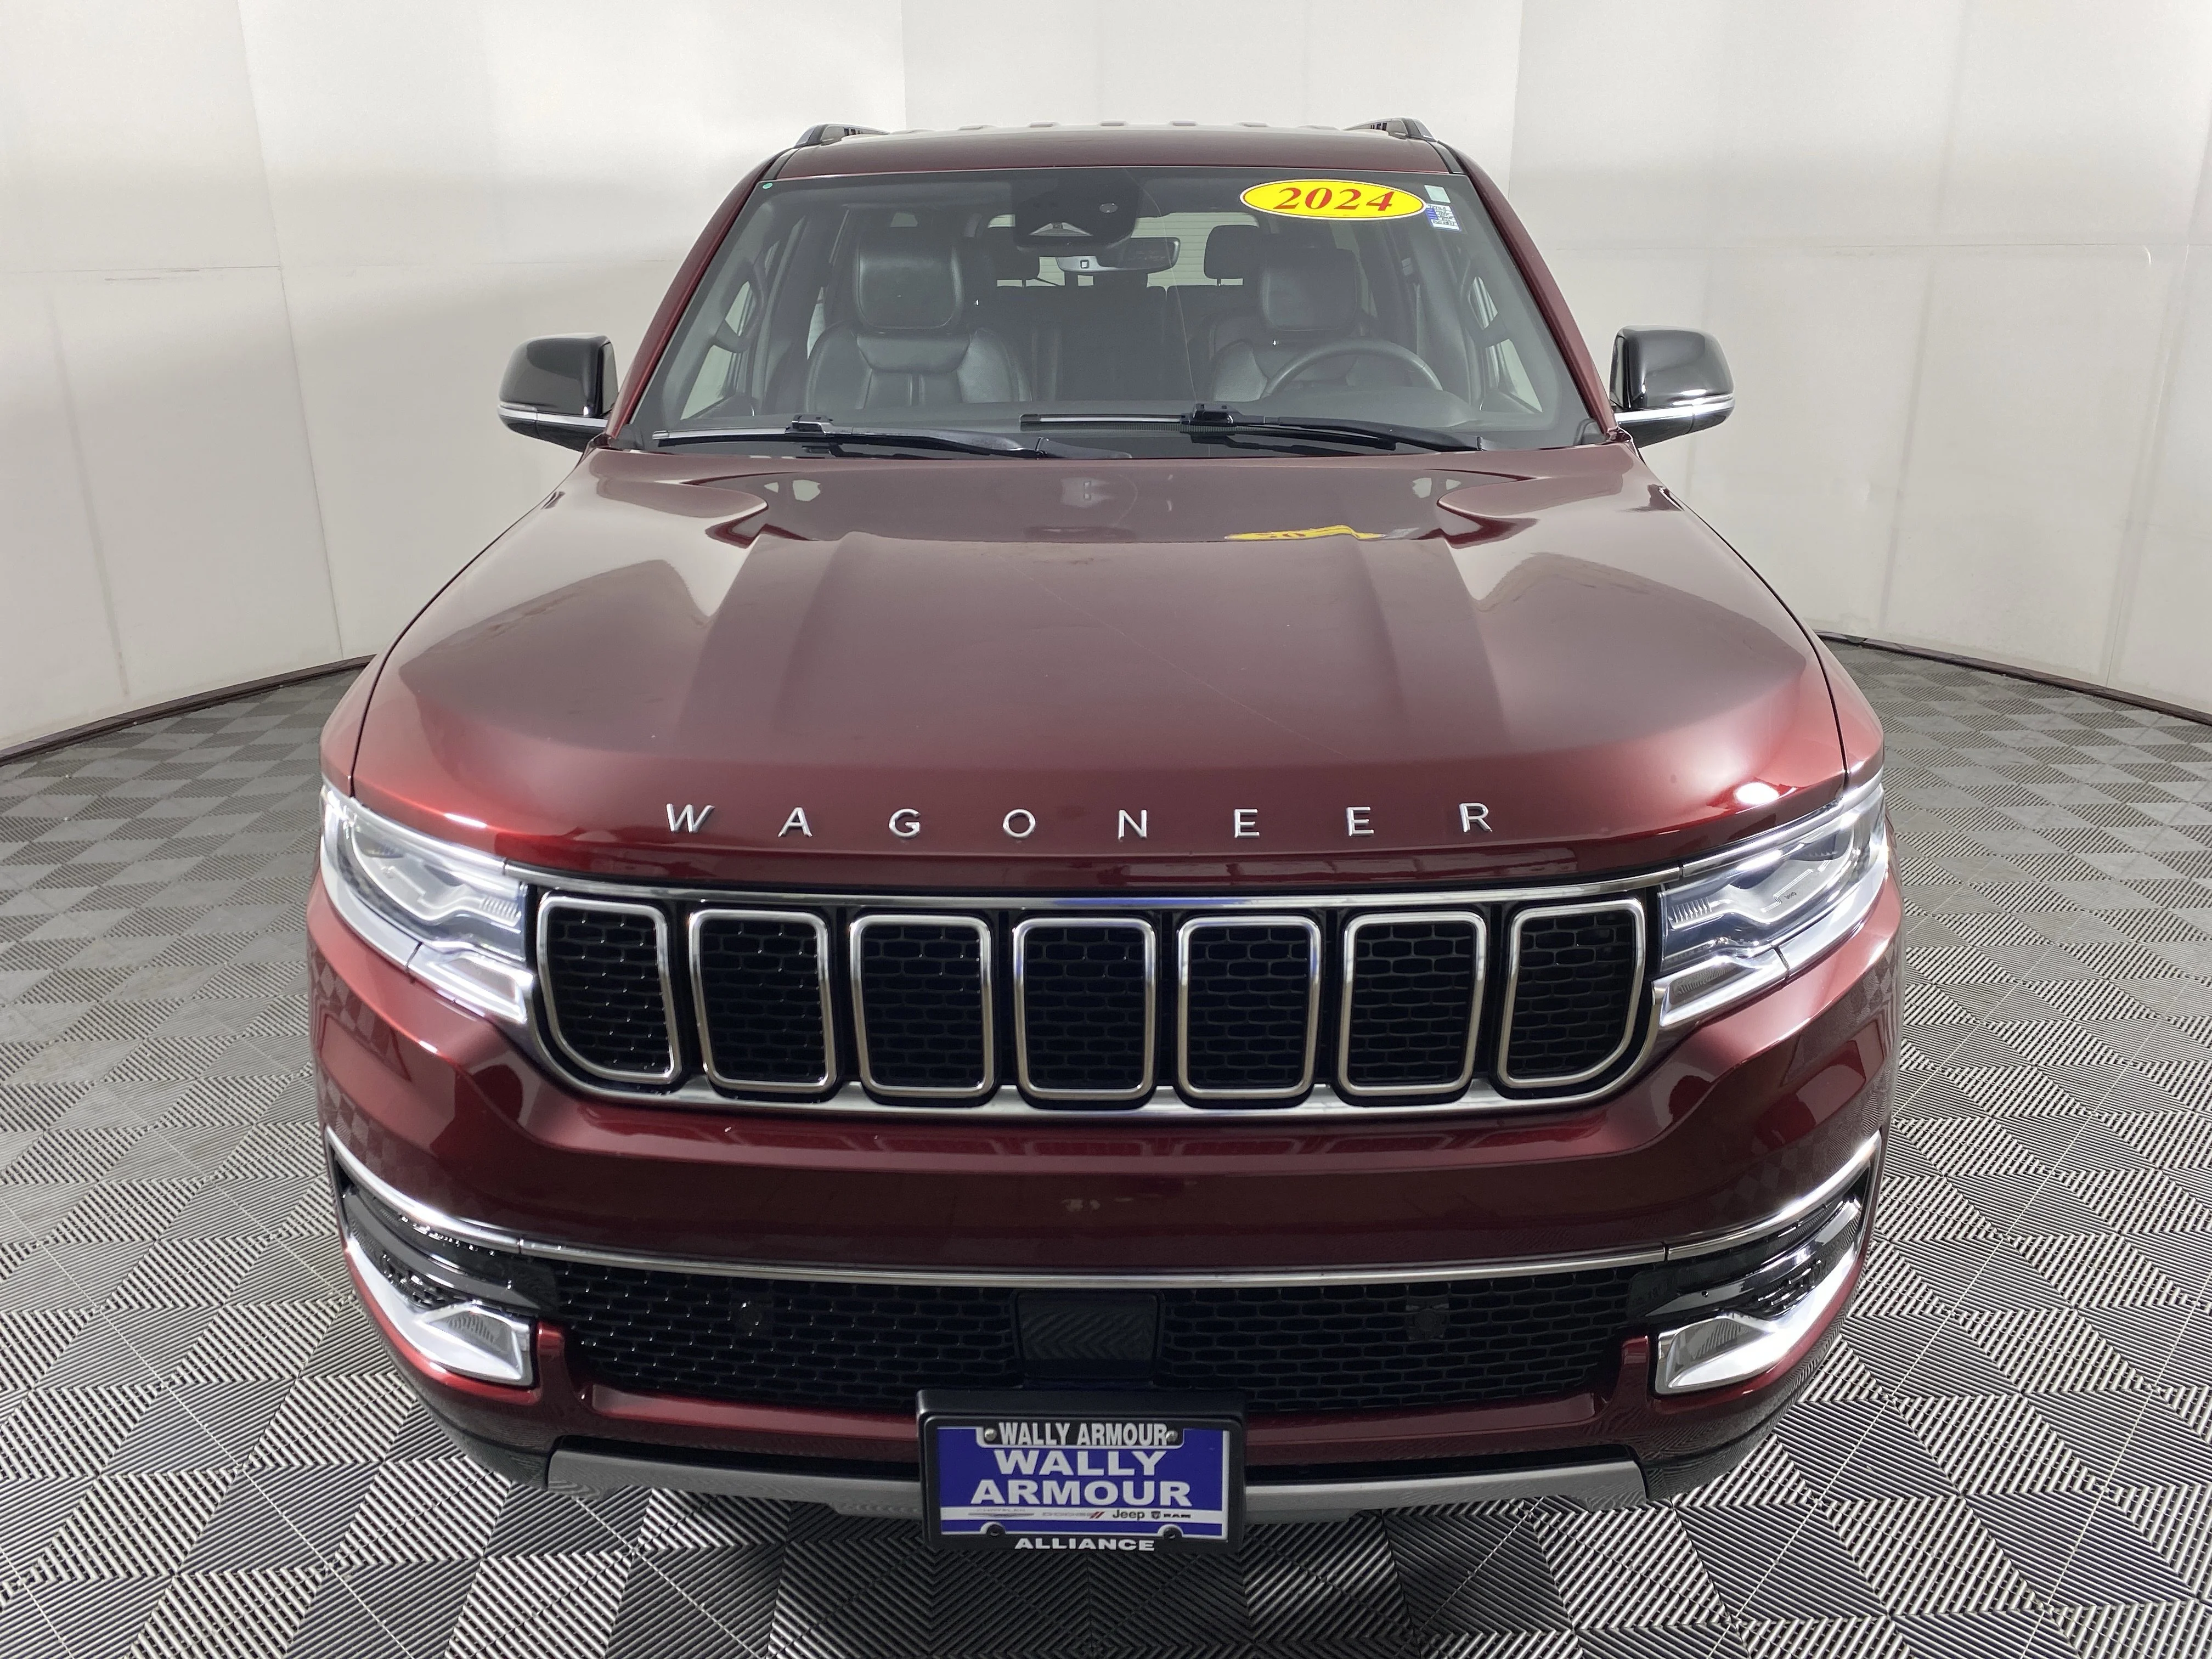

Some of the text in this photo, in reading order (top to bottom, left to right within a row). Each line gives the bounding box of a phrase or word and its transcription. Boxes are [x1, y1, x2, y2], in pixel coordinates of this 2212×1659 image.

[1273, 187, 1396, 211] 2024
[665, 802, 1493, 840] WAGONEER
[999, 1422, 1167, 1446] WALLY ARMOUR
[994, 1449, 1167, 1476] WALLY
[970, 1480, 1193, 1507] ARMOUR
[1112, 1509, 1146, 1520] Jeep
[1014, 1538, 1155, 1551] ALLIANCE
